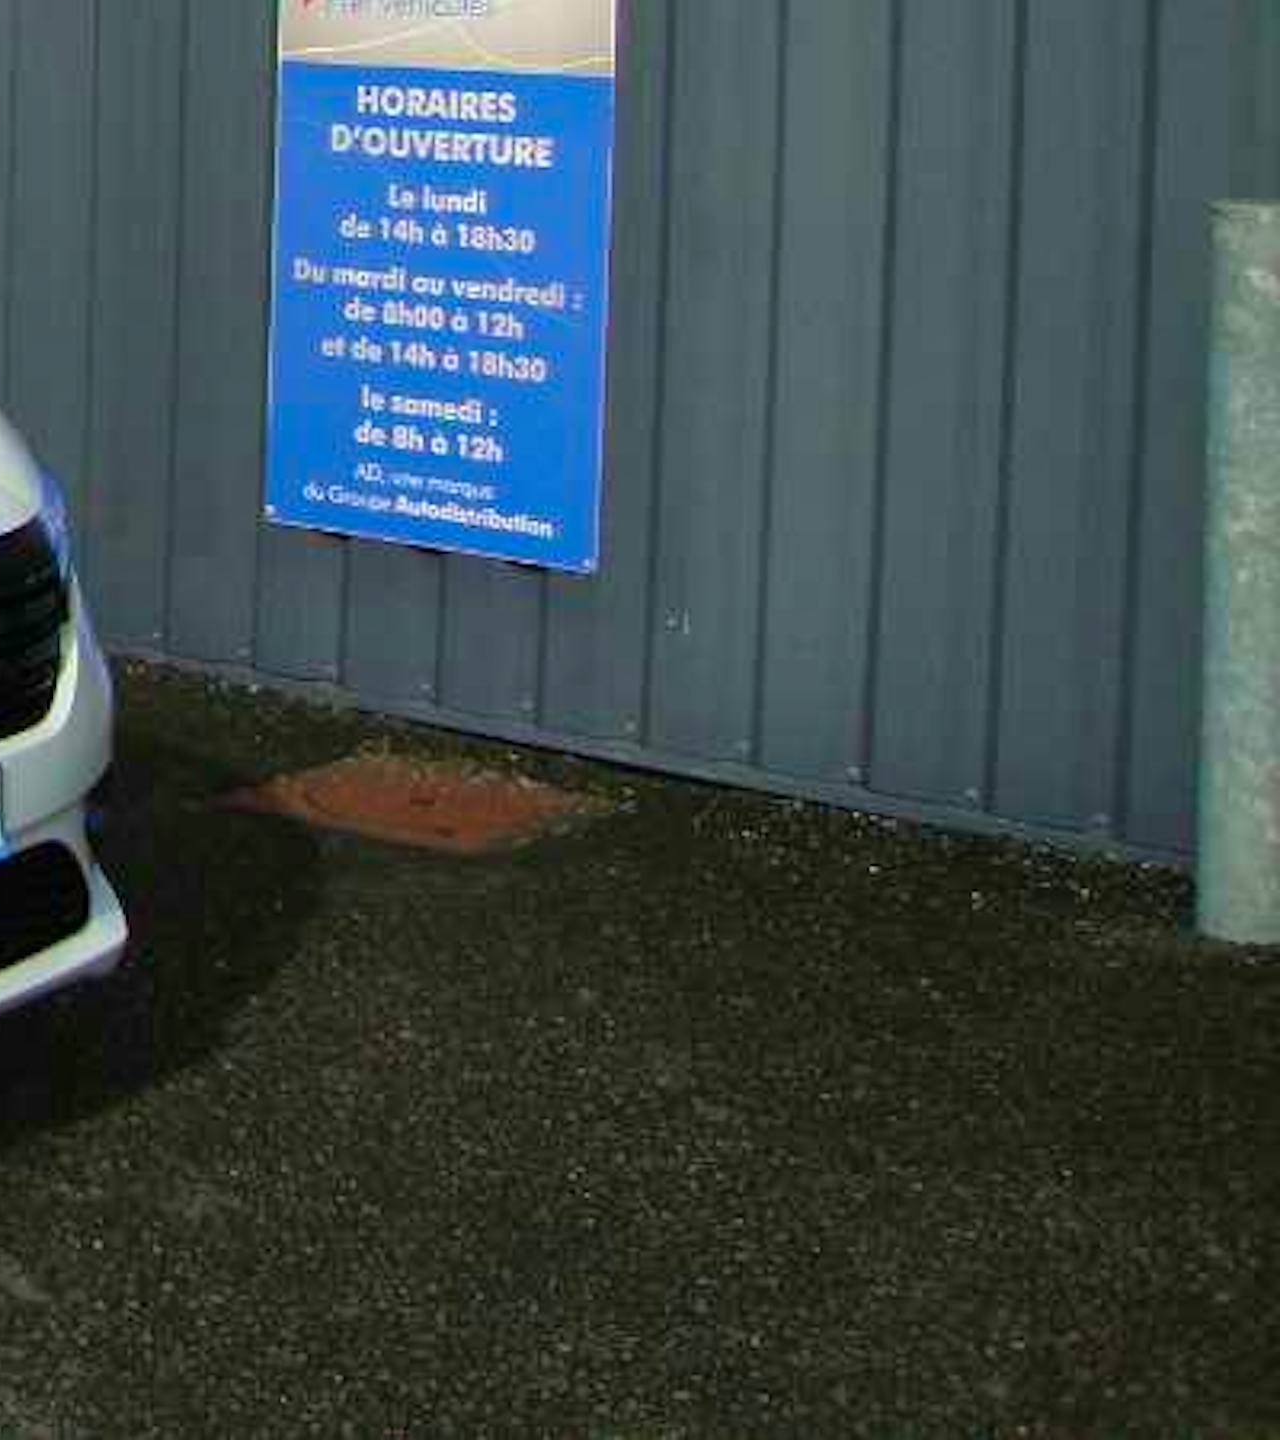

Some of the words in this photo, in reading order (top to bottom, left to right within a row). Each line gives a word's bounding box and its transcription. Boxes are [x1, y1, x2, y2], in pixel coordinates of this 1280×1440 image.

[356, 84, 518, 122] HORAIRES
[330, 123, 555, 168] D'OUVERTURE
[423, 186, 488, 214] lundi
[339, 214, 371, 239] de
[380, 216, 423, 245] 14h
[458, 223, 536, 253] 18h30
[293, 259, 326, 283] Du
[333, 266, 406, 292] mardi
[412, 275, 445, 295] au
[452, 277, 566, 310] vendredi
[343, 297, 376, 322] de
[478, 311, 524, 340] 12h
[321, 337, 345, 357] et
[352, 337, 383, 362] de
[391, 341, 436, 370] 14h
[468, 350, 547, 382] 18h30
[391, 393, 482, 424] samedi
[354, 420, 387, 446] de
[392, 423, 424, 451] 8h
[457, 434, 503, 464] 12h
[395, 494, 554, 539] Autodistribution
